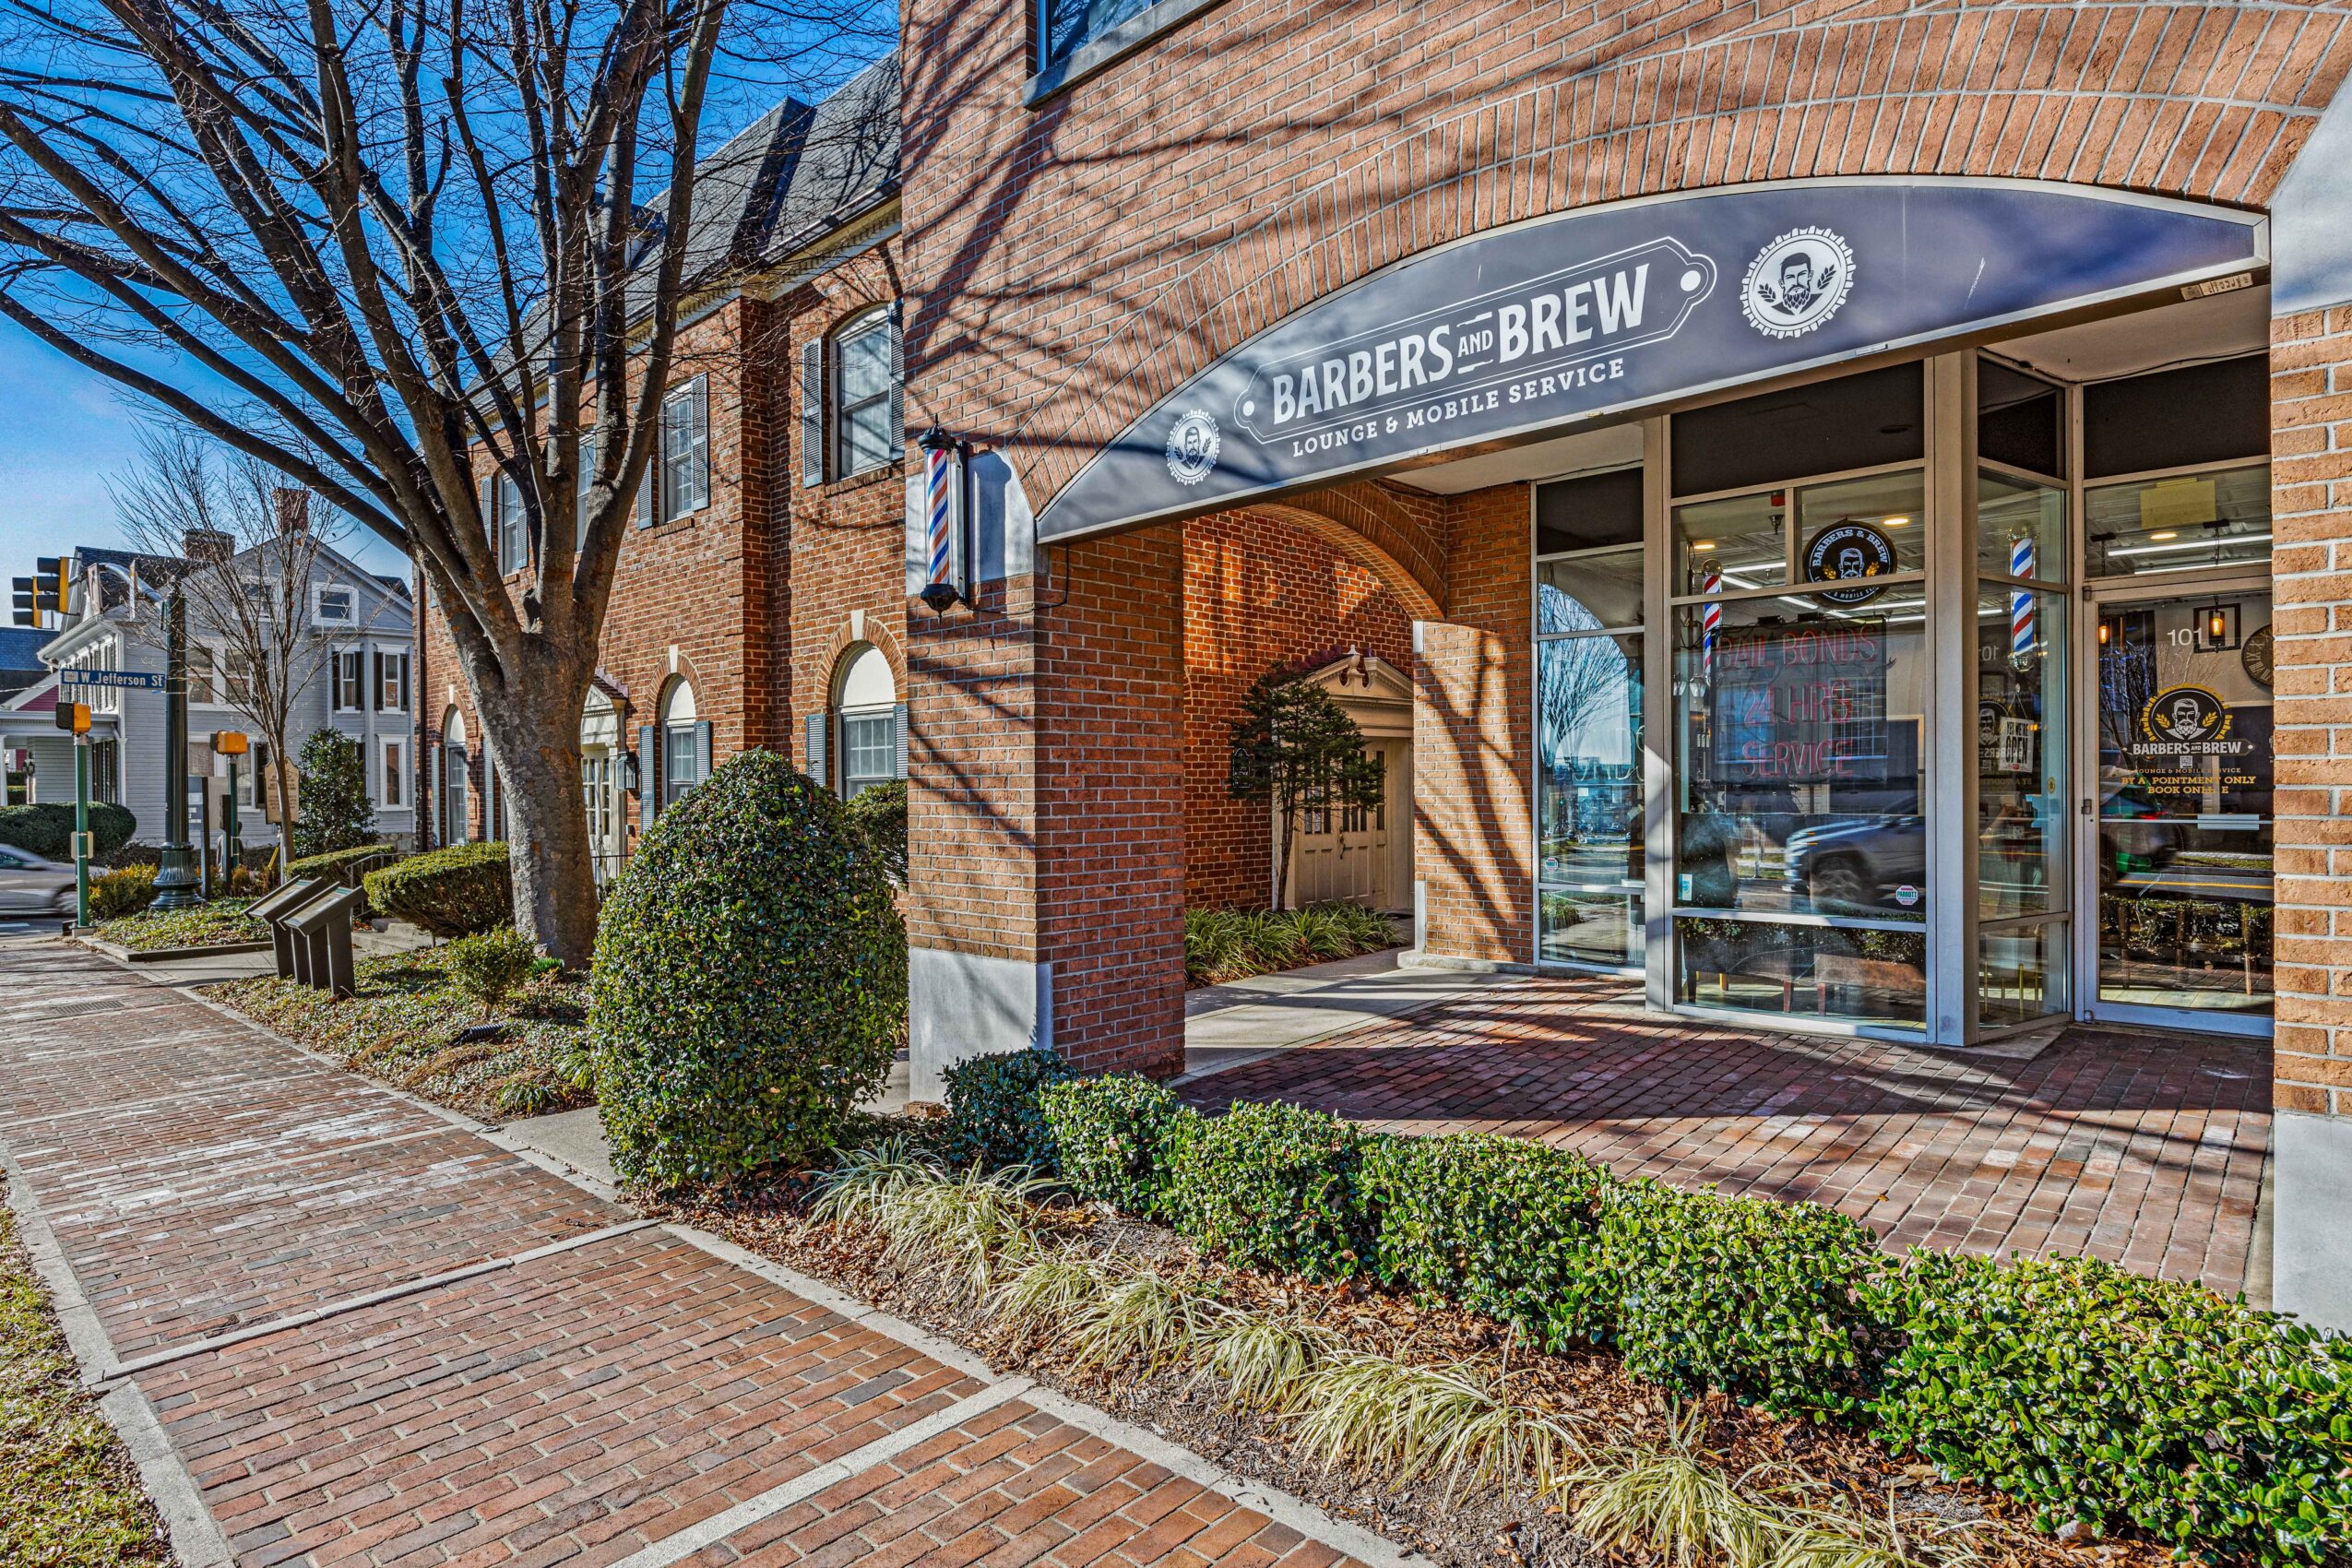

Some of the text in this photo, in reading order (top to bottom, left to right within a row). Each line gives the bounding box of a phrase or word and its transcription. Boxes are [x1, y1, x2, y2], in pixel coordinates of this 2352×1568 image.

[1273, 263, 1649, 424] BARBERS AND BREW
[1293, 358, 1623, 457] LOUNGE & MOBILE SERVICE
[1812, 529, 1854, 567] BARBERS
[1866, 533, 1888, 564] BREW
[1716, 624, 1879, 671] BAIL BONDS
[2167, 627, 2203, 646] 101
[1742, 679, 1853, 727] 24 HRS
[1740, 739, 1855, 778] SERVICE
[2006, 736, 2027, 764] OPEN
[2132, 742, 2190, 755] BARBERS
[2203, 742, 2242, 754] BREW
[2121, 777, 2136, 785] BY
[2224, 776, 2257, 784] ONLY
[2148, 786, 2180, 794] BOOK
